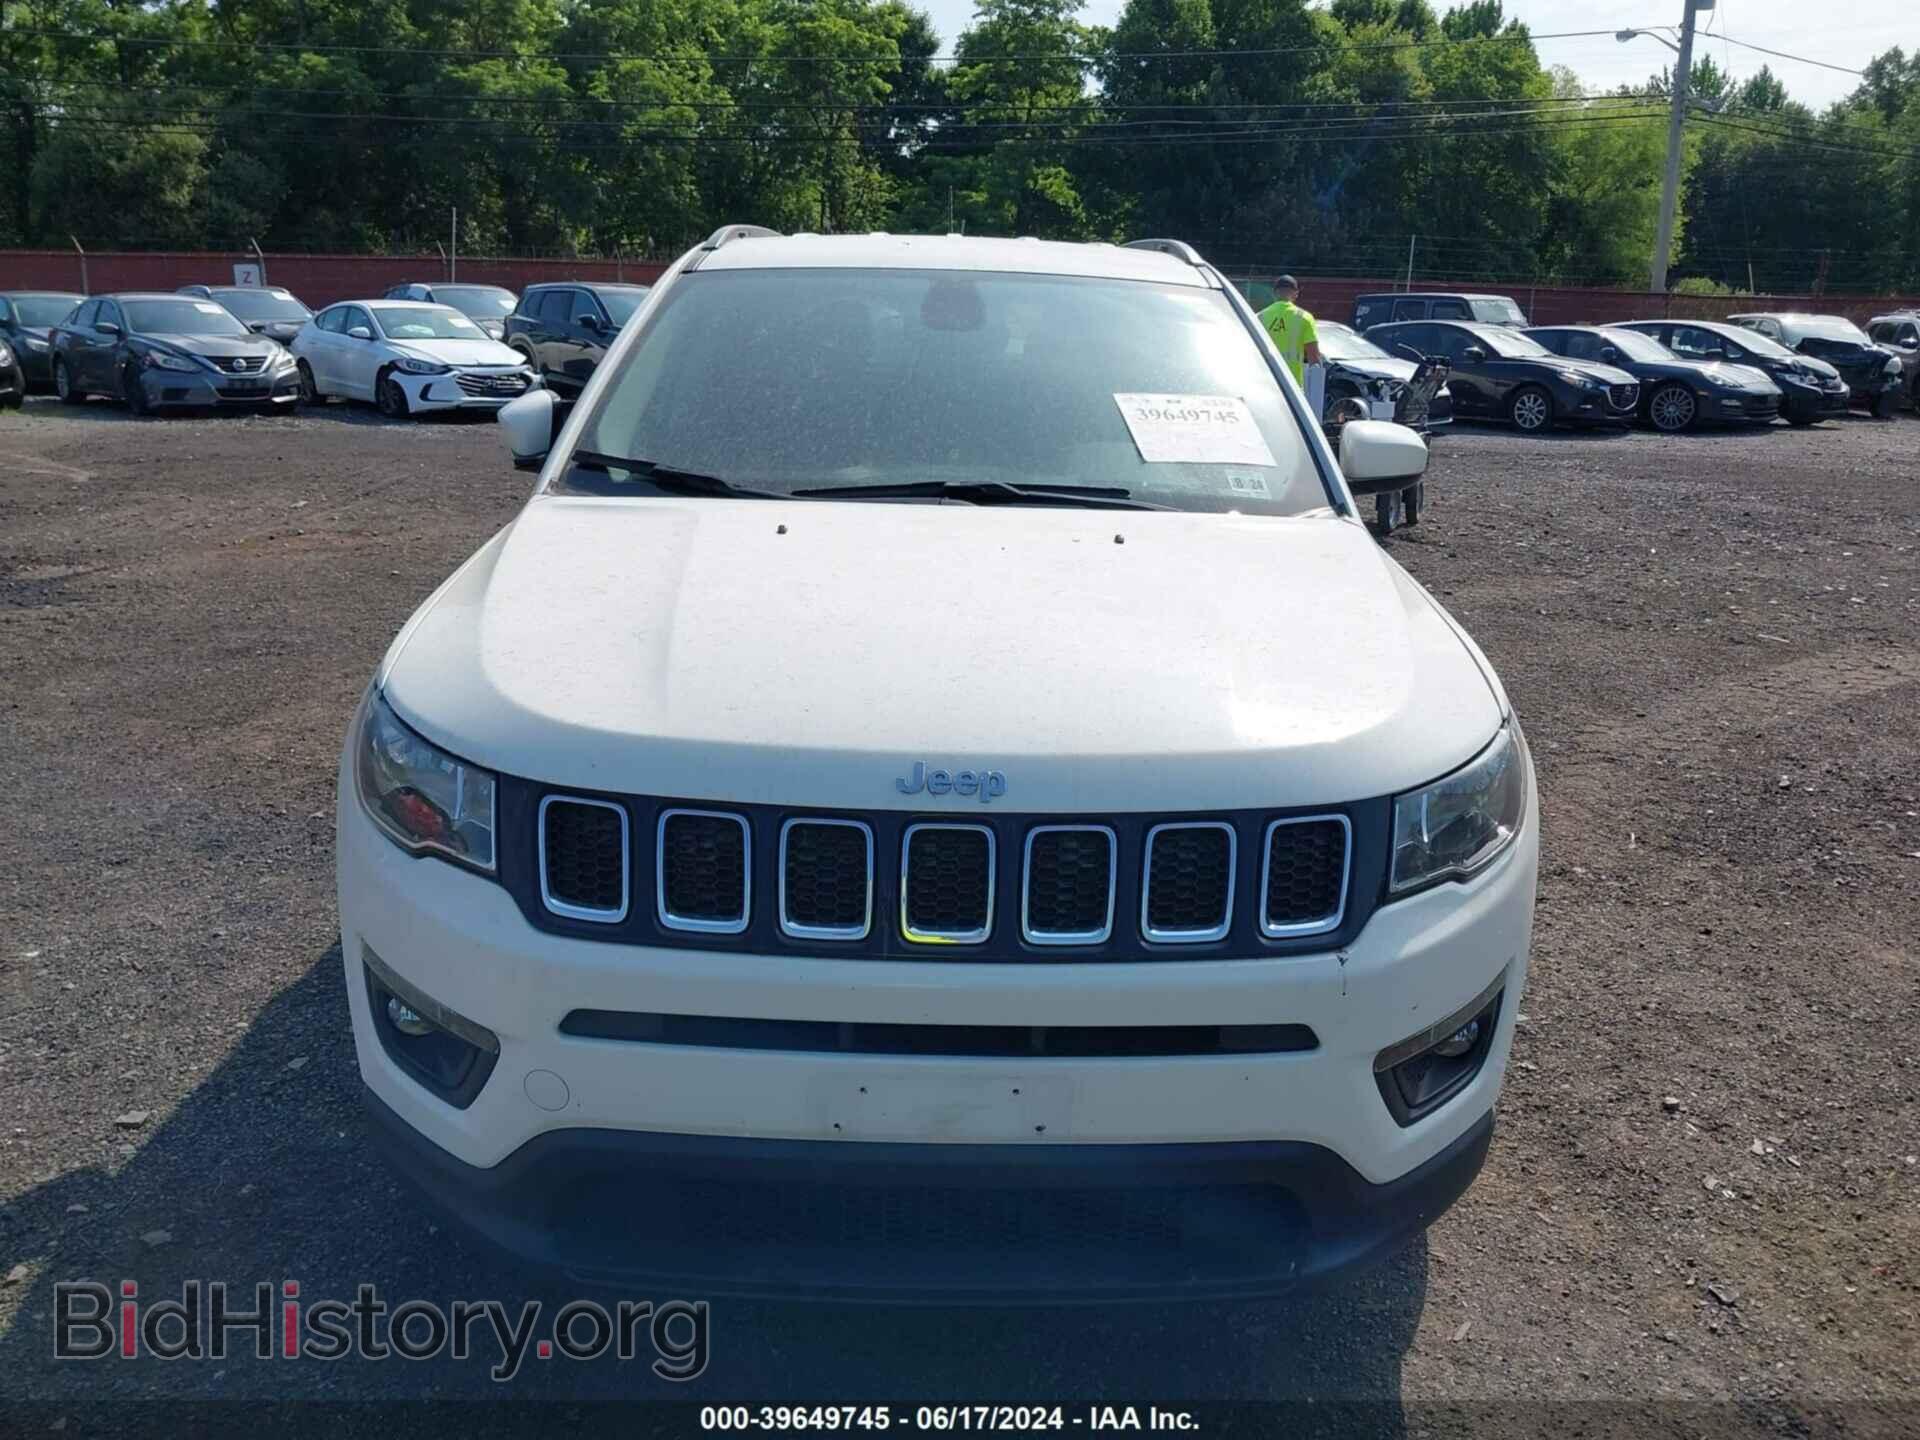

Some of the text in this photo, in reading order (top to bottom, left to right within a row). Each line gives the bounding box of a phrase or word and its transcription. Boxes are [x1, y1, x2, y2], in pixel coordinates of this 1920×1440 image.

[243, 272, 252, 284] Z
[1135, 408, 1240, 424] 39649745
[896, 760, 1007, 804] Jeep
